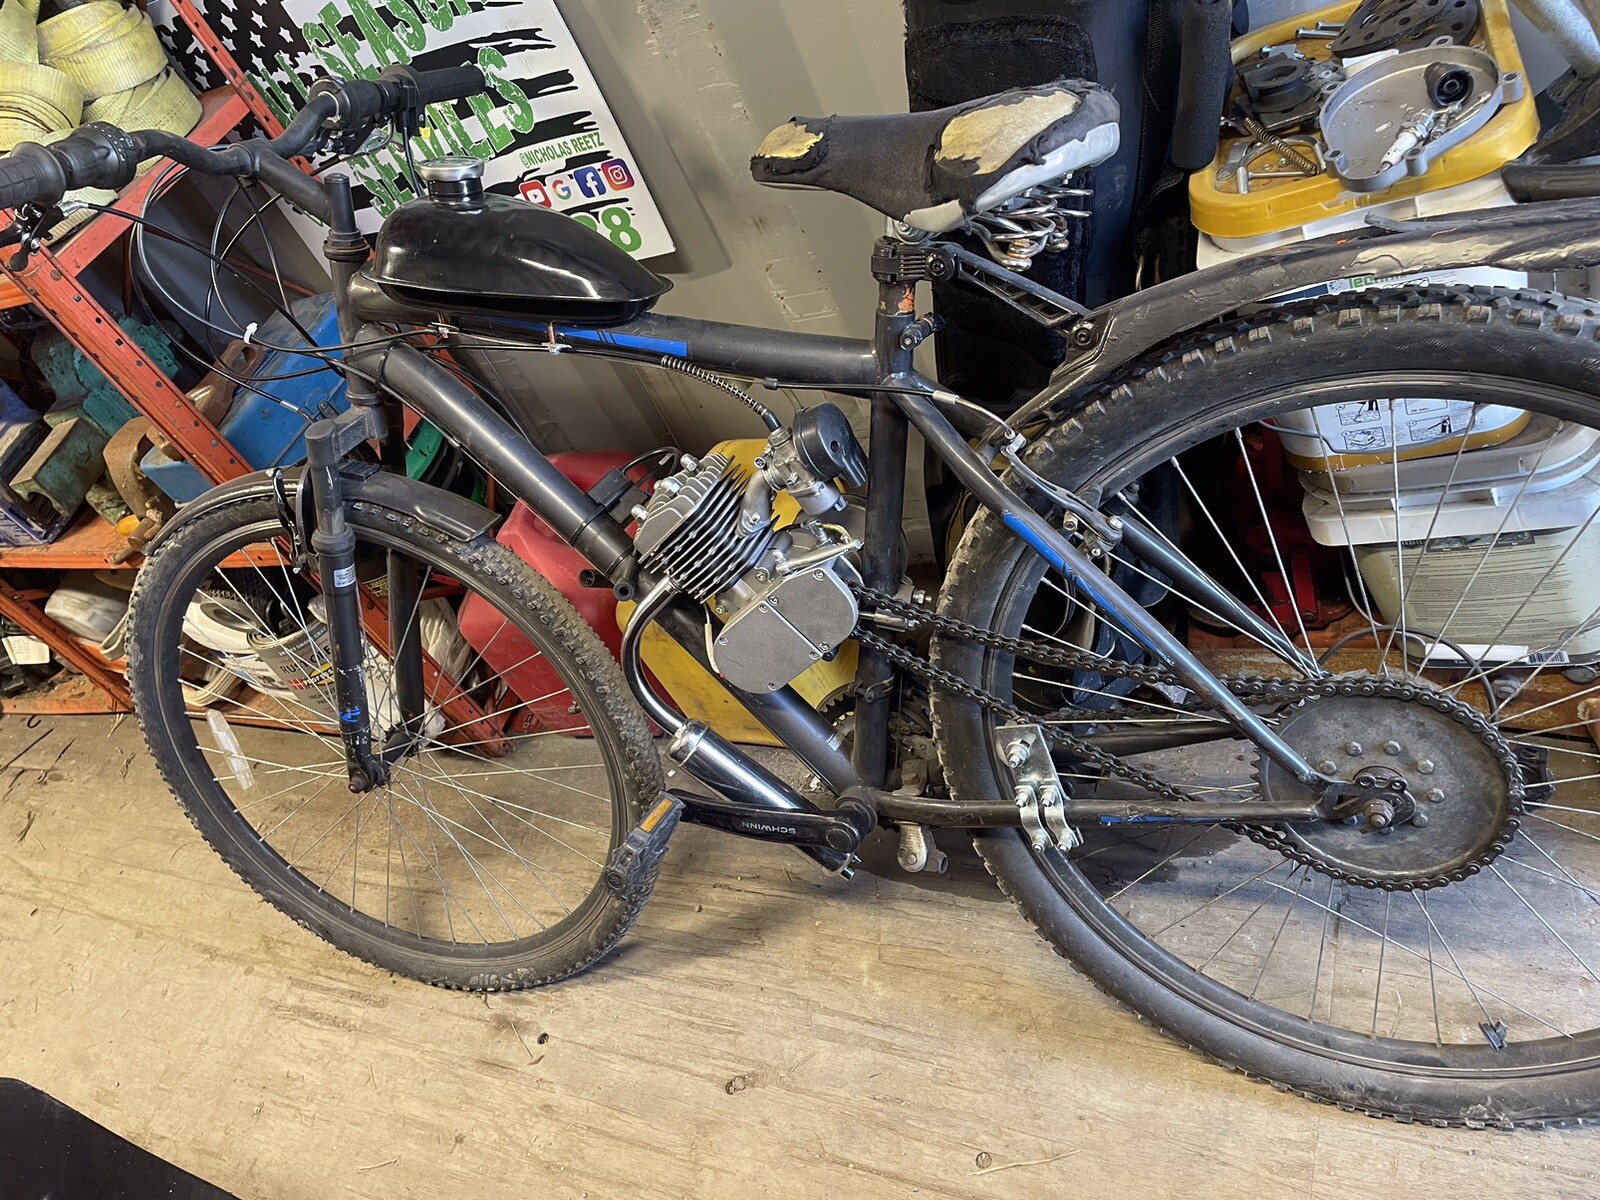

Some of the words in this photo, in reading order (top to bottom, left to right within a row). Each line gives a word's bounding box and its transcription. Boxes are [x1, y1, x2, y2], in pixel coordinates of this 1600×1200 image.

[519, 141, 573, 168] @NICHOLAS
[570, 131, 605, 154] REETZ
[313, 625, 326, 639] GRAY
[742, 821, 796, 834] SCHWINN
